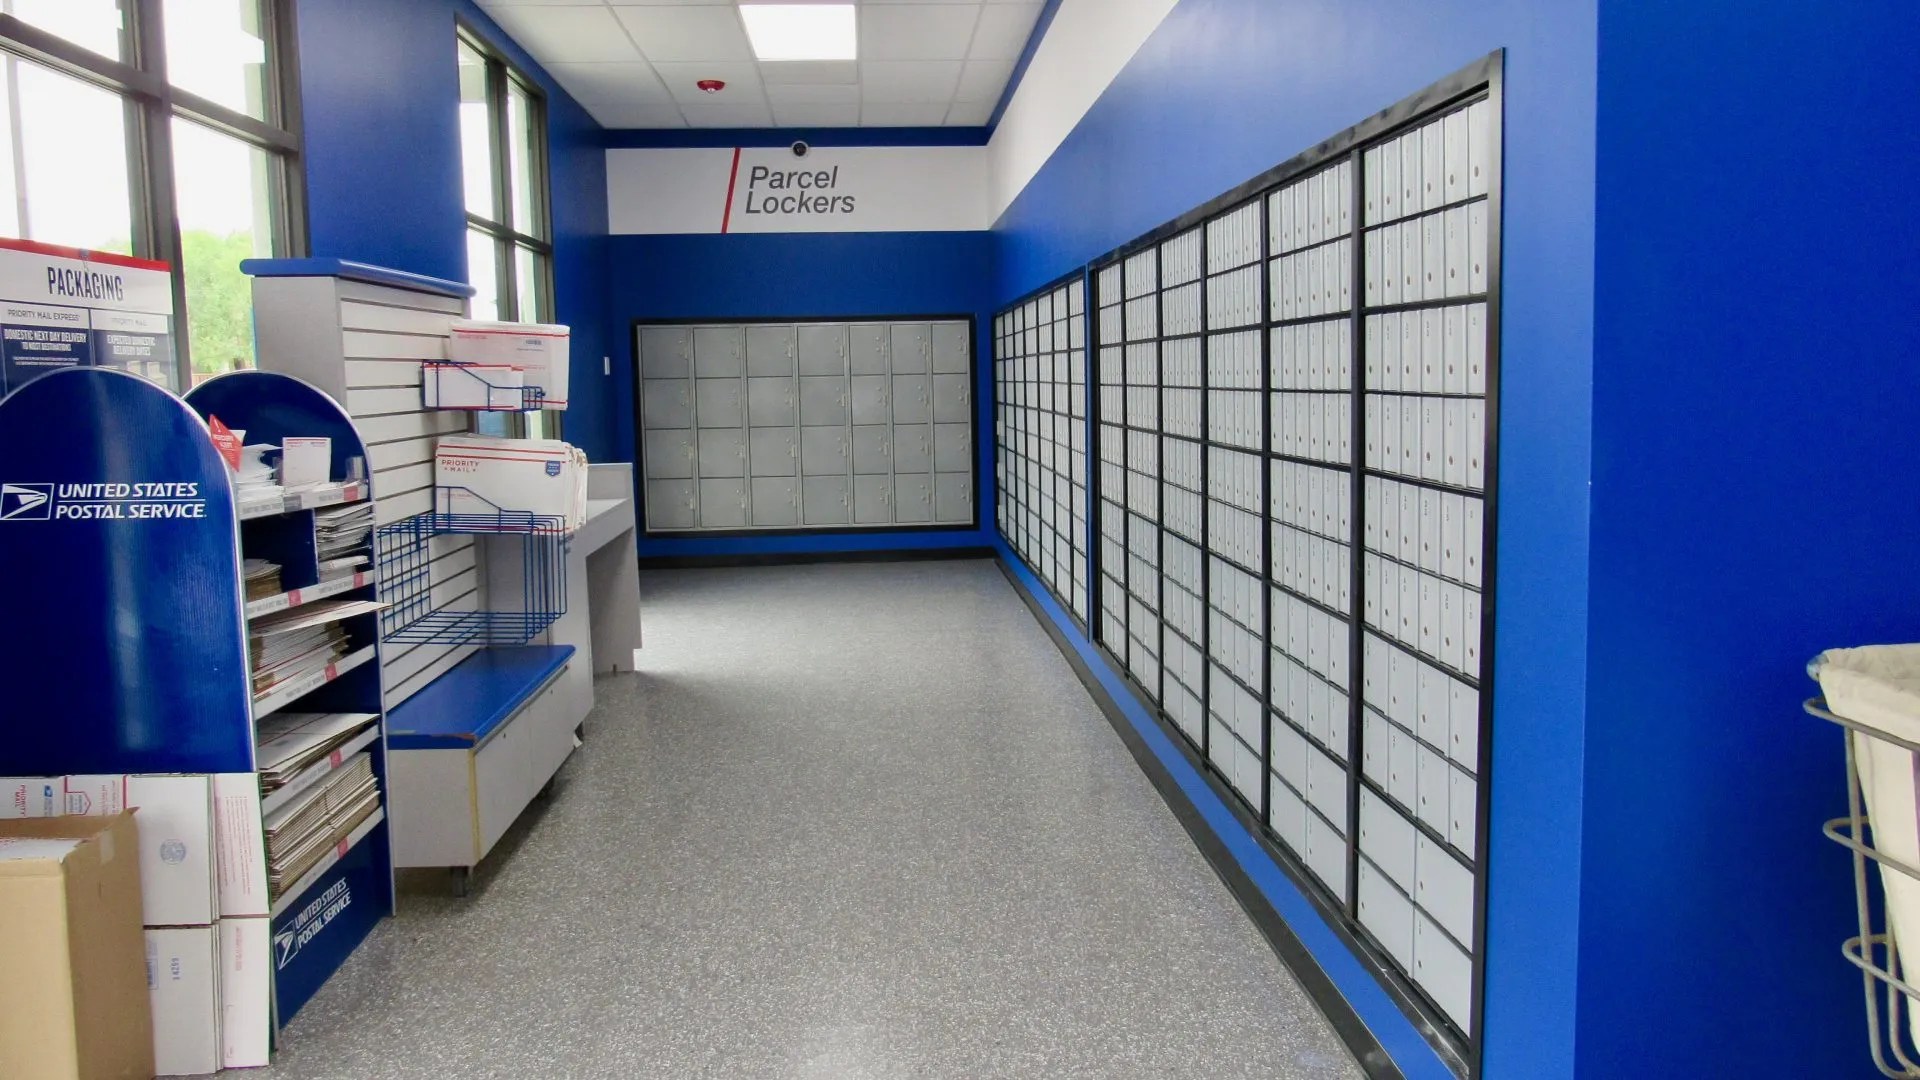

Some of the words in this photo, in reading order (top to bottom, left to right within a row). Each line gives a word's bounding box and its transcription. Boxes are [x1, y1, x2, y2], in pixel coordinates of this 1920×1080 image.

[749, 165, 839, 190] Parcel
[745, 191, 856, 214] Lockers
[47, 266, 124, 301] PACKAGING
[8, 309, 36, 318] PRIORITY
[37, 311, 52, 320] MAIL
[4, 329, 34, 340] DOMESTIC
[34, 330, 49, 342] NEXT
[49, 331, 61, 342] DAY
[61, 332, 87, 343] DELIVERY
[441, 459, 480, 467] PRIORITY
[58, 483, 130, 498] UNITED
[132, 482, 198, 497] STATES
[55, 503, 125, 519] POSTAL
[295, 897, 322, 930] UNITED
[321, 876, 347, 906] STATES
[297, 917, 324, 949] POSTAL
[323, 891, 351, 925] SERVICE
